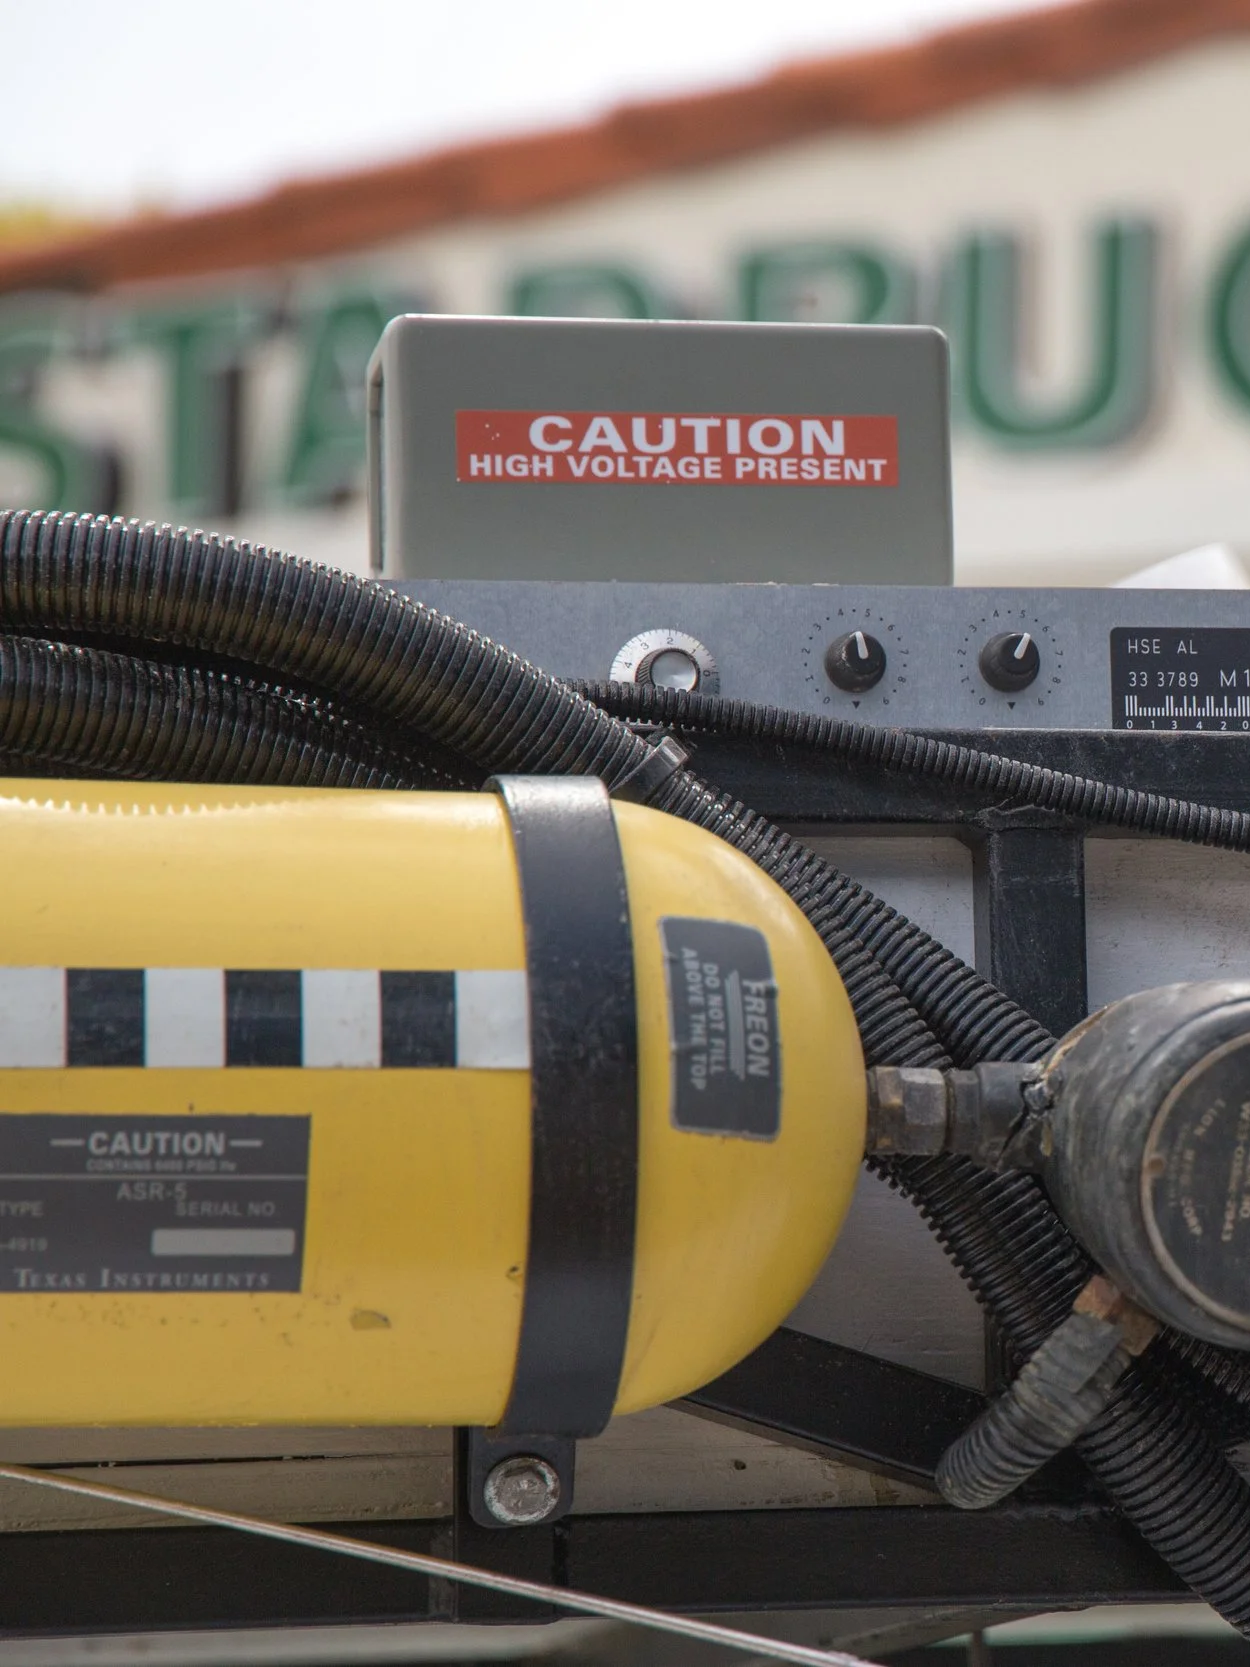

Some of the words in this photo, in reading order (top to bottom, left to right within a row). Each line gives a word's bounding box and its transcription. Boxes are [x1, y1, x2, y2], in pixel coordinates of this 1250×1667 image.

[528, 416, 845, 455] CAUTION
[469, 454, 554, 477] HIGH
[567, 455, 723, 479] VOLTAGE
[735, 458, 888, 481] PRESENT
[813, 623, 821, 631] 3
[838, 608, 844, 616] 4
[865, 609, 871, 617] 5
[969, 624, 977, 632] 3
[993, 609, 999, 617] 4
[1020, 610, 1026, 618] 5
[625, 661, 632, 669] 4
[641, 642, 649, 650] 3
[666, 637, 674, 645] 2
[1128, 639, 1161, 654] HSE
[1177, 639, 1198, 654] AL
[1128, 671, 1148, 687] 33
[1157, 671, 1199, 687] 3789
[1126, 719, 1133, 729] 0
[1151, 720, 1155, 729] 1
[1171, 720, 1178, 729] 3
[1196, 720, 1203, 729] 4
[1220, 721, 1227, 730] 2
[1242, 720, 1249, 729] 0
[681, 947, 705, 1007] ABOVE
[702, 962, 720, 989] DO
[707, 994, 725, 1032] NOT
[690, 1013, 707, 1046] THE
[742, 979, 770, 1077] FREON
[709, 1038, 726, 1076] FILL
[691, 1053, 707, 1090] TOP
[87, 1131, 226, 1156] CAUTION
[116, 1182, 188, 1201] ASR-5
[175, 1201, 242, 1217] SERIAL
